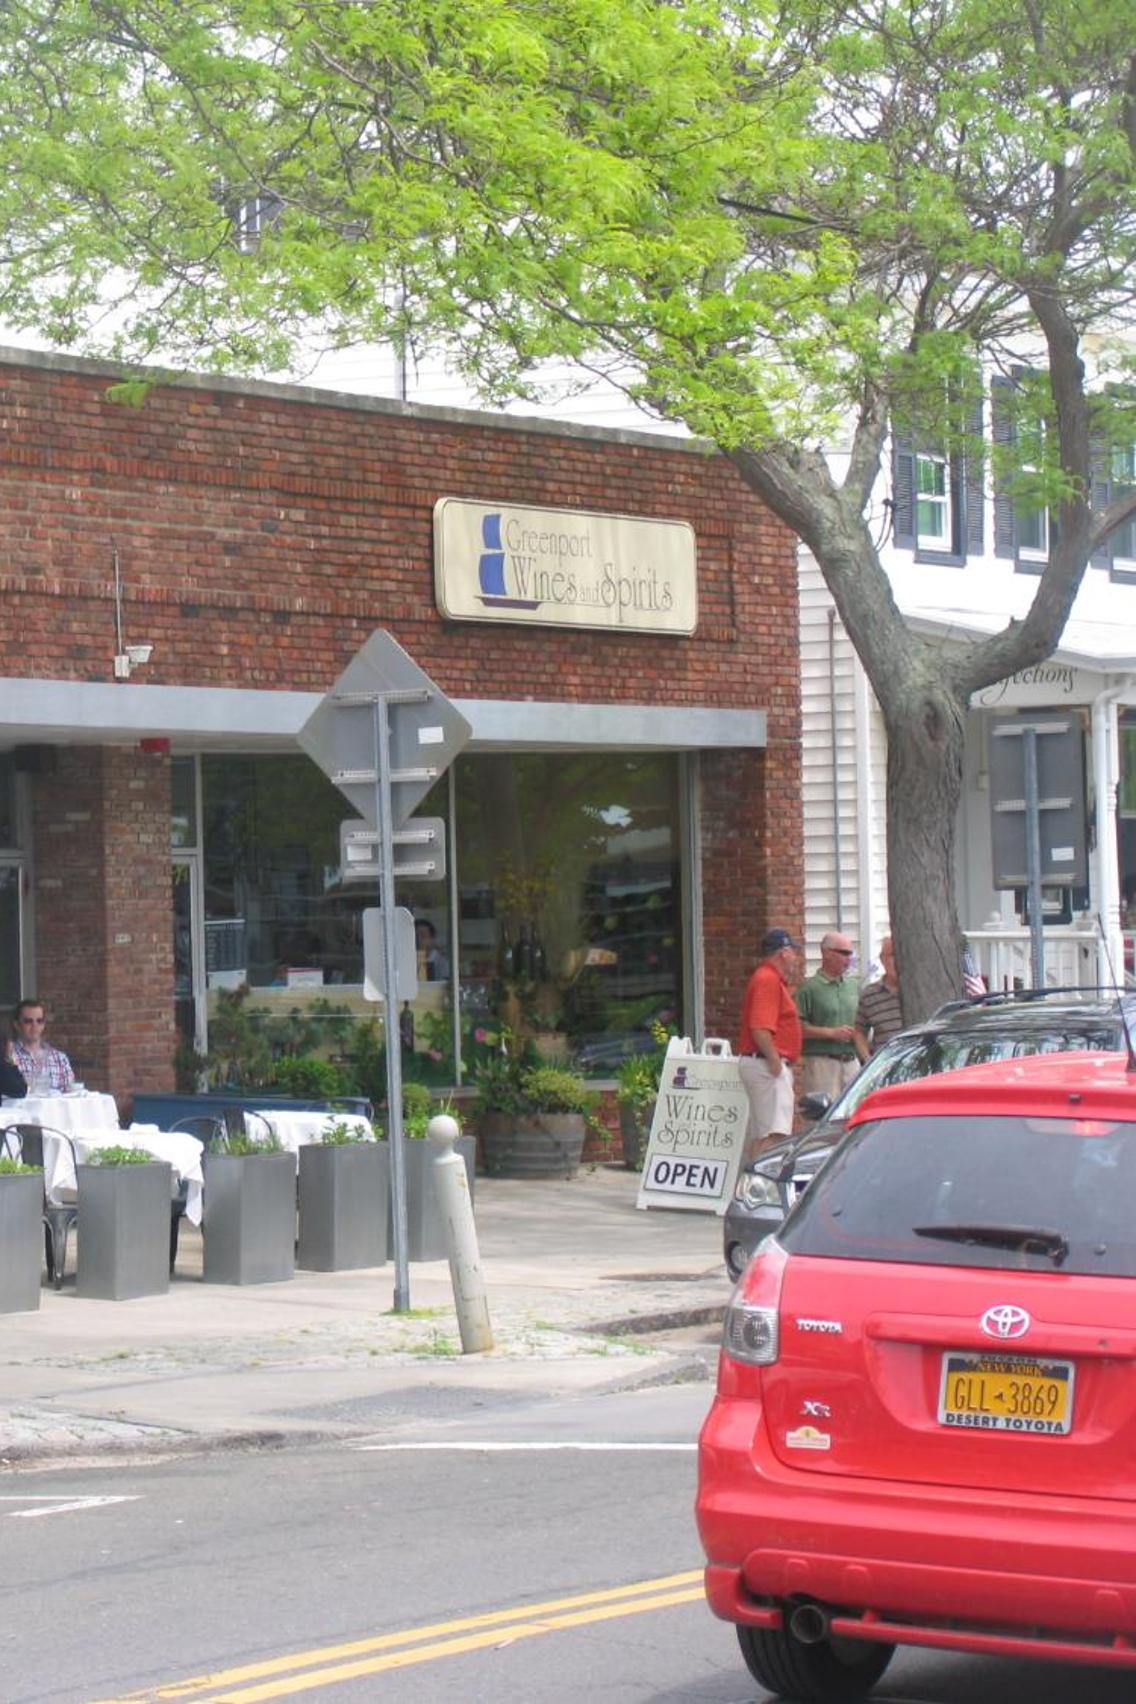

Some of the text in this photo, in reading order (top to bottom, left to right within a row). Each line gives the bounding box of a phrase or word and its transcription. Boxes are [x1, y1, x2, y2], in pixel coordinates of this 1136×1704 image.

[505, 518, 593, 568] Greenport
[511, 555, 577, 604] Wines
[601, 562, 674, 623] Spirits
[665, 1093, 738, 1124] Wines
[657, 1119, 734, 1152] Spirits
[654, 1160, 719, 1190] OPEN
[796, 1318, 843, 1333] TOYOTA
[978, 1361, 1042, 1377] NEW YORK
[954, 1377, 1059, 1416] GLL 3869
[946, 1412, 1064, 1433] DESERT TOYOTA
